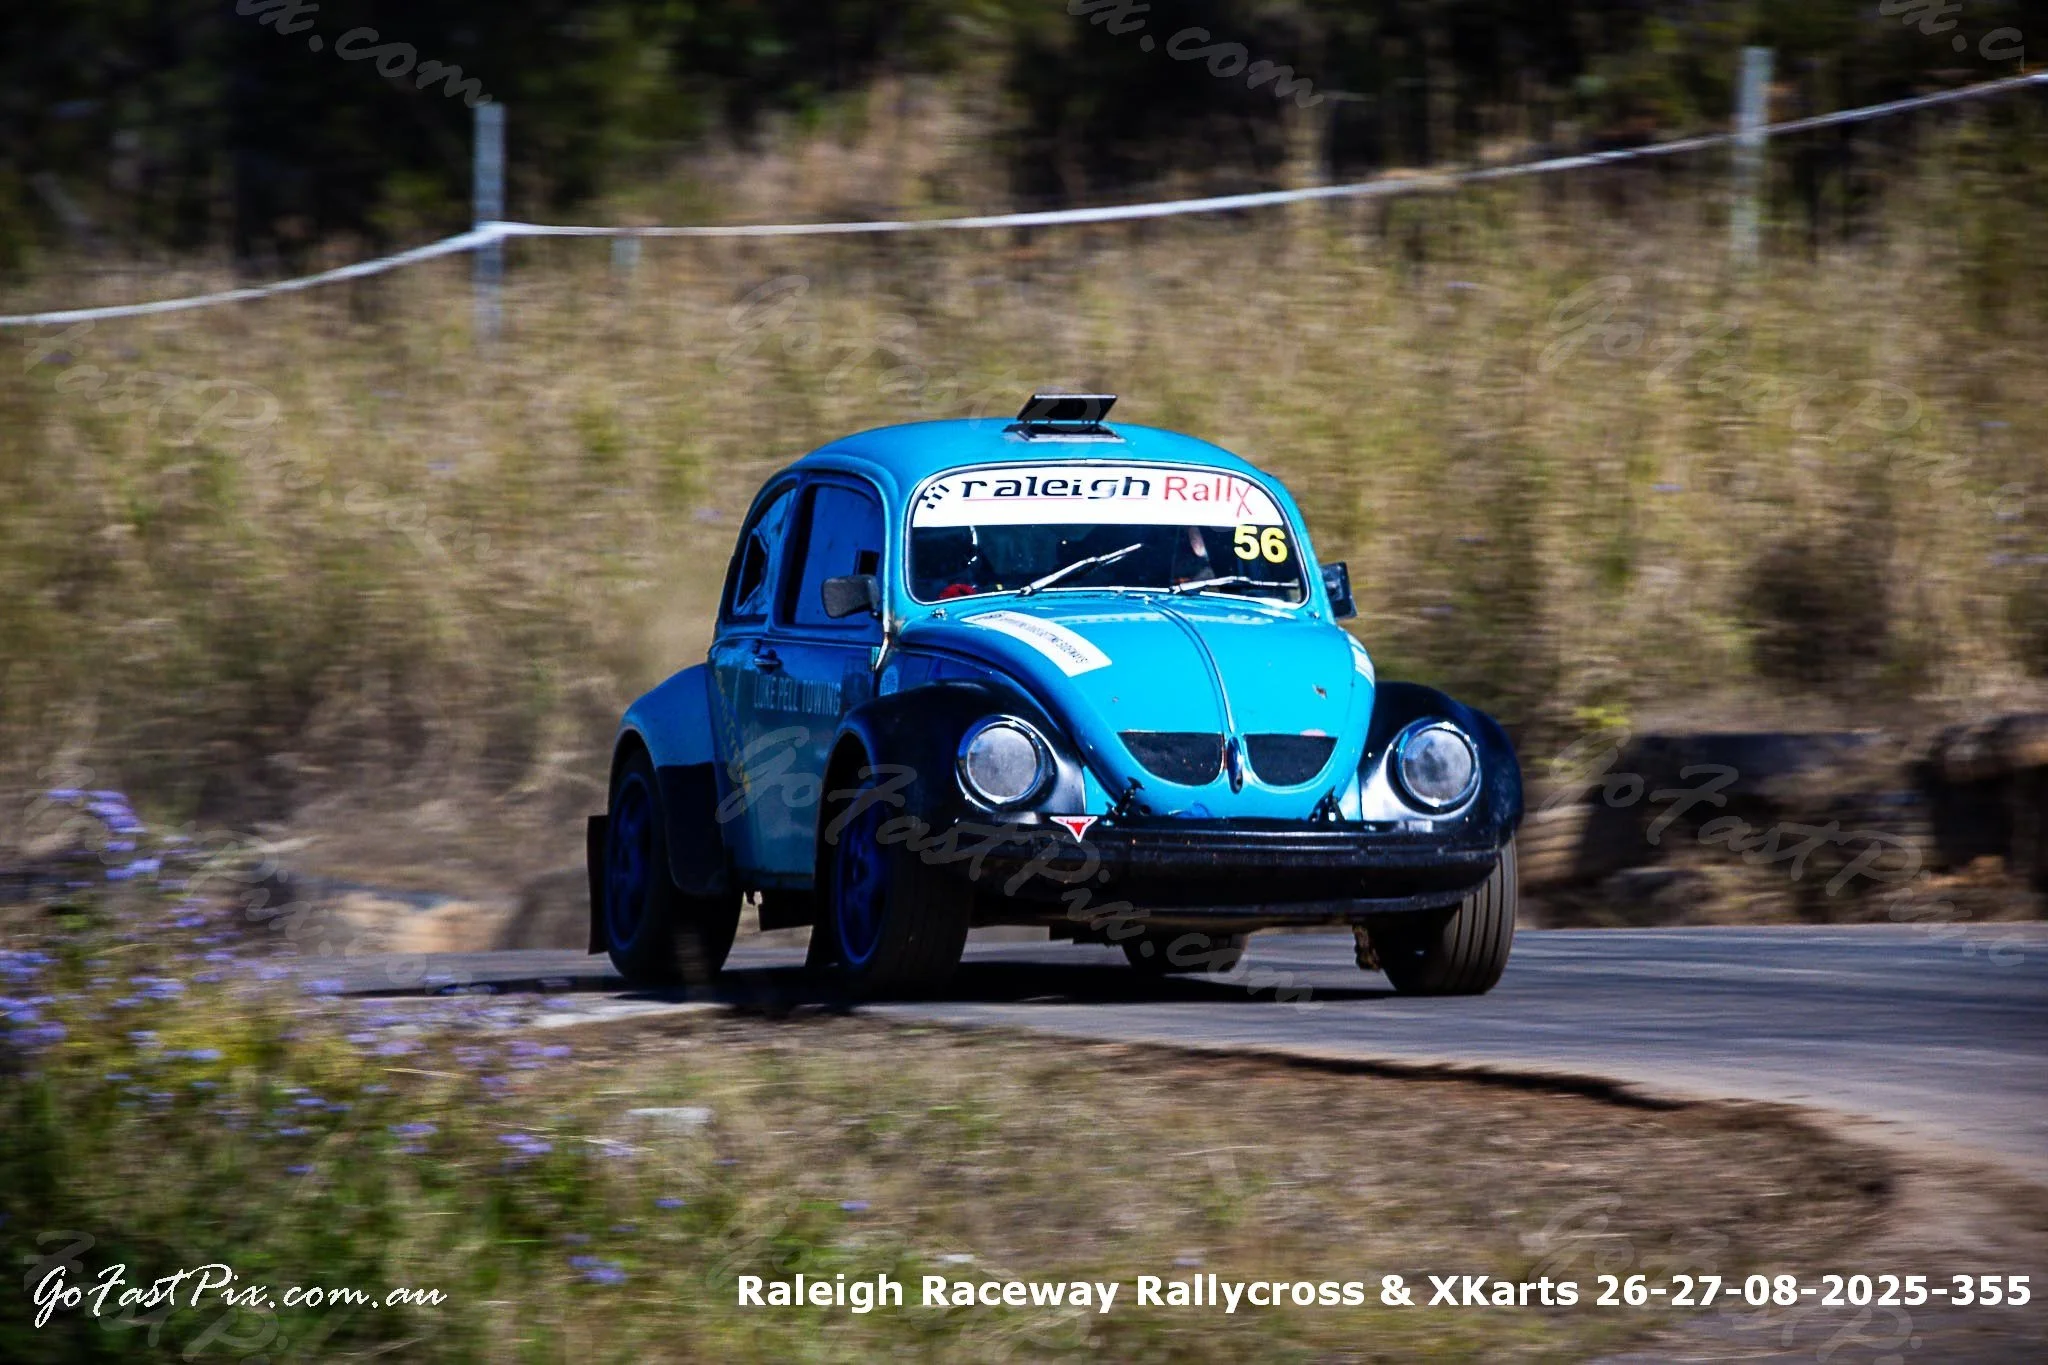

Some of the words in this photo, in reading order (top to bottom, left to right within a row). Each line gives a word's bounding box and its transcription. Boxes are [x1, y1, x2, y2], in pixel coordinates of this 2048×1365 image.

[961, 475, 1150, 499] raleigh
[1233, 525, 1288, 563] 56
[777, 677, 799, 713] PELL
[802, 679, 842, 717] TOWING
